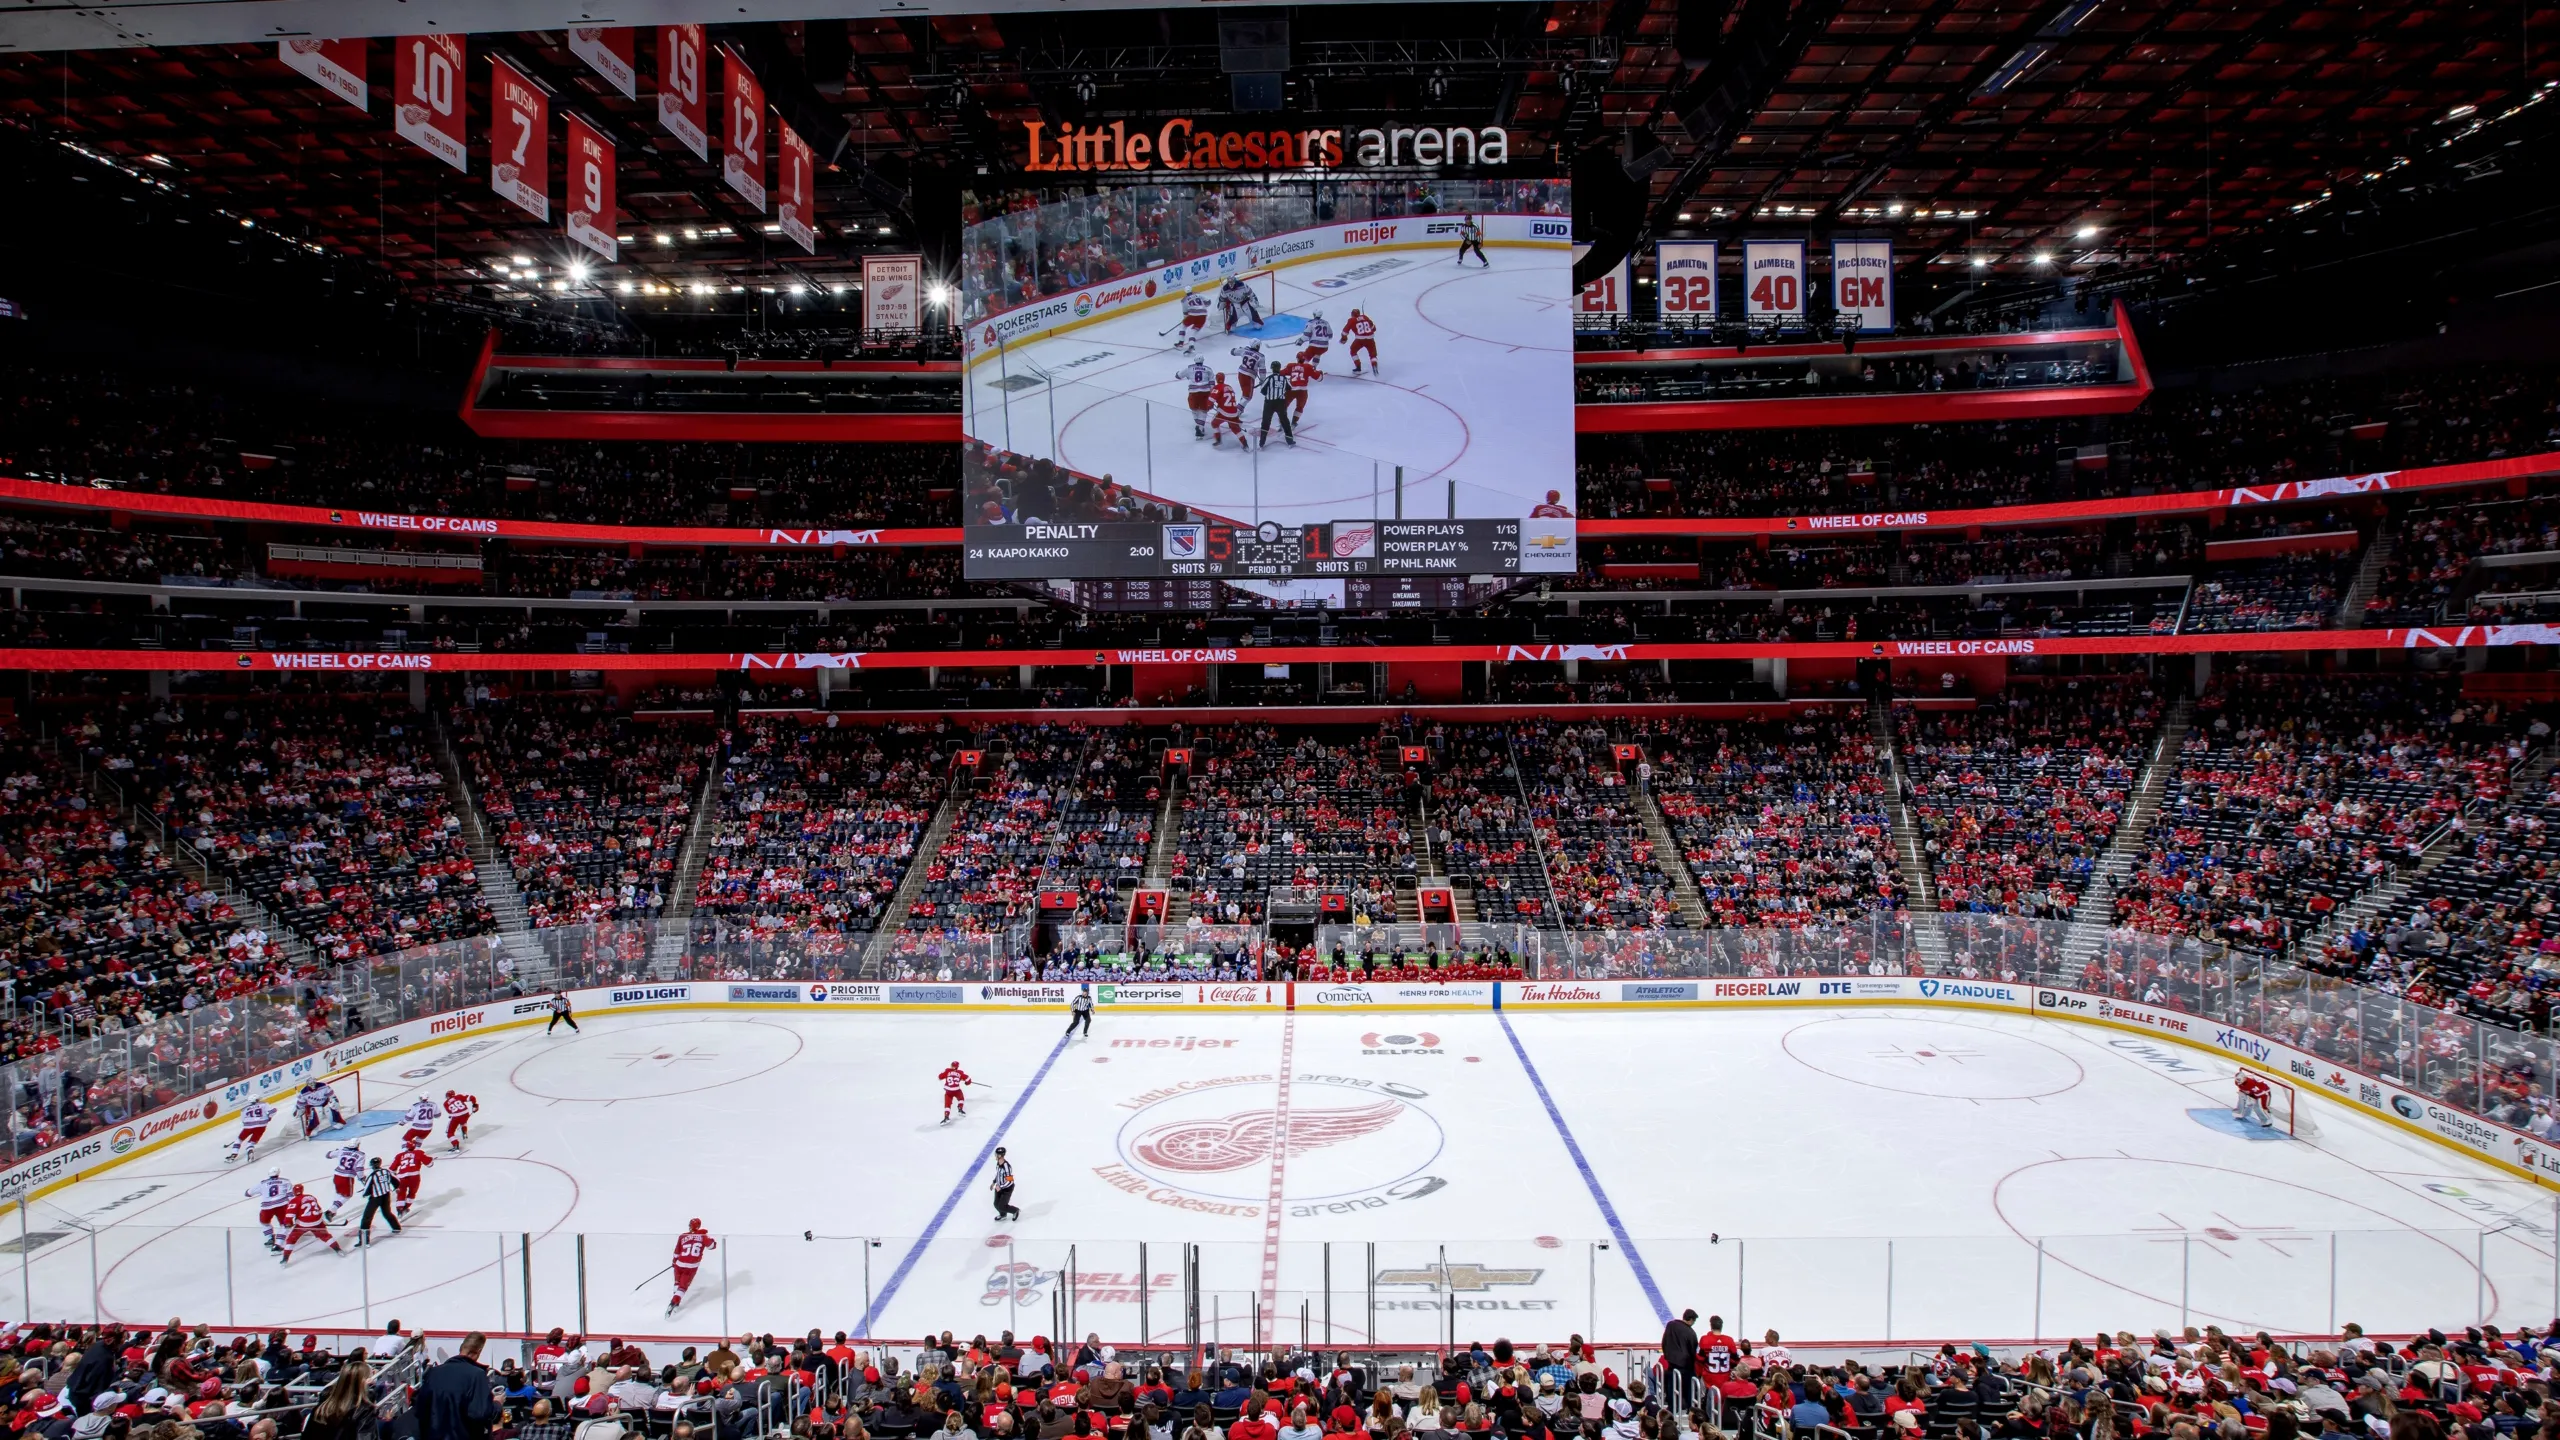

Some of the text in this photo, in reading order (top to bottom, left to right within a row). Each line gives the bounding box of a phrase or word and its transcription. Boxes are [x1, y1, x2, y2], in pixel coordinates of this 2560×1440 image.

[668, 29, 697, 105] 19
[317, 63, 358, 97] 1947-1960
[412, 41, 452, 116] 10
[738, 73, 754, 105] ABEL
[504, 82, 538, 120] LINDSAY
[511, 107, 531, 167] 7
[733, 96, 758, 165] 12
[424, 131, 457, 158] 1950-1974
[583, 137, 602, 164] HOWE
[1023, 118, 1508, 172] Little Caesars arena
[584, 161, 601, 214] 9
[793, 156, 801, 206] 1
[1344, 223, 1398, 245] meijer
[1533, 224, 1568, 235] BUD
[1260, 239, 1315, 260] Little Caesars
[1666, 258, 1708, 271] HAMILTON
[1754, 258, 1795, 270] LAIMBEER
[1095, 283, 1143, 309] Campari
[1582, 276, 1618, 312] 21
[1664, 276, 1710, 311] 32
[1750, 275, 1797, 311] 40
[1840, 276, 1885, 307] GM
[1074, 302, 1094, 313] SUNSET
[997, 302, 1068, 332] POKERSTARS
[1018, 322, 1040, 334] CASINO
[1315, 326, 1327, 337] 20
[1356, 321, 1370, 334] 88
[358, 512, 498, 533] WHEEL OF CAMS
[1808, 512, 1927, 529] WHEEL OF CAMS
[1025, 525, 1098, 539] PENALTY
[1383, 525, 1518, 535] POWER PLAYS 1/13
[1208, 528, 1231, 559] 5
[1306, 527, 1328, 559] 1
[1383, 542, 1518, 551] POWER PLAY % 7.7%
[969, 547, 1154, 558] 24 KAAPO KAKKO 2:00
[1237, 544, 1301, 564] 12:58
[1172, 563, 1205, 573] SHOTS
[1248, 566, 1277, 574] PERIOD
[1316, 561, 1366, 572] SHOTS 19
[1384, 558, 1518, 568] PP NHL RANK 27
[1126, 581, 1150, 589] 15:55
[1188, 581, 1211, 589] 15:35
[1126, 591, 1150, 600] 14:29
[1188, 591, 1211, 599] 15:26
[1188, 600, 1211, 608] 14:35
[1897, 640, 2035, 654] WHEEL OF CAMS
[271, 654, 432, 668] WHEEL OF CAMS
[1117, 649, 1237, 662] WHEEL OF CAMS
[613, 988, 688, 1003] BUD LIGHT
[747, 988, 797, 999] Rewards
[831, 986, 880, 994] PRIORITY
[896, 990, 924, 1000] xfinity
[994, 986, 1065, 999] Michigan First
[1102, 988, 1181, 1001] enterprise
[1210, 986, 1257, 1002] Coca-Cola
[1520, 984, 1601, 1001] Tim Hortons
[1819, 983, 1852, 994] DTE
[1943, 985, 2015, 1000] FANDUEL
[430, 1011, 485, 1035] meijer
[2113, 1007, 2188, 1033] BELLE TIRE
[340, 1034, 399, 1063] Little Caesars
[1110, 1035, 1240, 1051] meijer
[2216, 1029, 2271, 1062] xfinity
[2291, 1060, 2315, 1080] Blue
[1115, 1073, 1373, 1111] Little Caesars arena
[2360, 1083, 2381, 1099] Blue
[418, 1108, 433, 1120] 20
[139, 1107, 200, 1142] Campari
[2428, 1106, 2499, 1143] Gallagher
[110, 1136, 136, 1152] SUNSET
[2437, 1123, 2488, 1150] INSURANCE
[1, 1141, 101, 1193] POKERSTARS
[32, 1170, 62, 1186] CASINO
[269, 1185, 279, 1197] 8
[1091, 1162, 1389, 1218] Little Caesars arena
[301, 1202, 320, 1217] 23
[681, 1242, 702, 1257] 56
[1065, 1272, 1180, 1287] BELLE
[1076, 1289, 1158, 1303] TIRE
[1373, 1300, 1557, 1311] CHEVROLET
[1708, 1352, 1730, 1373] 53
